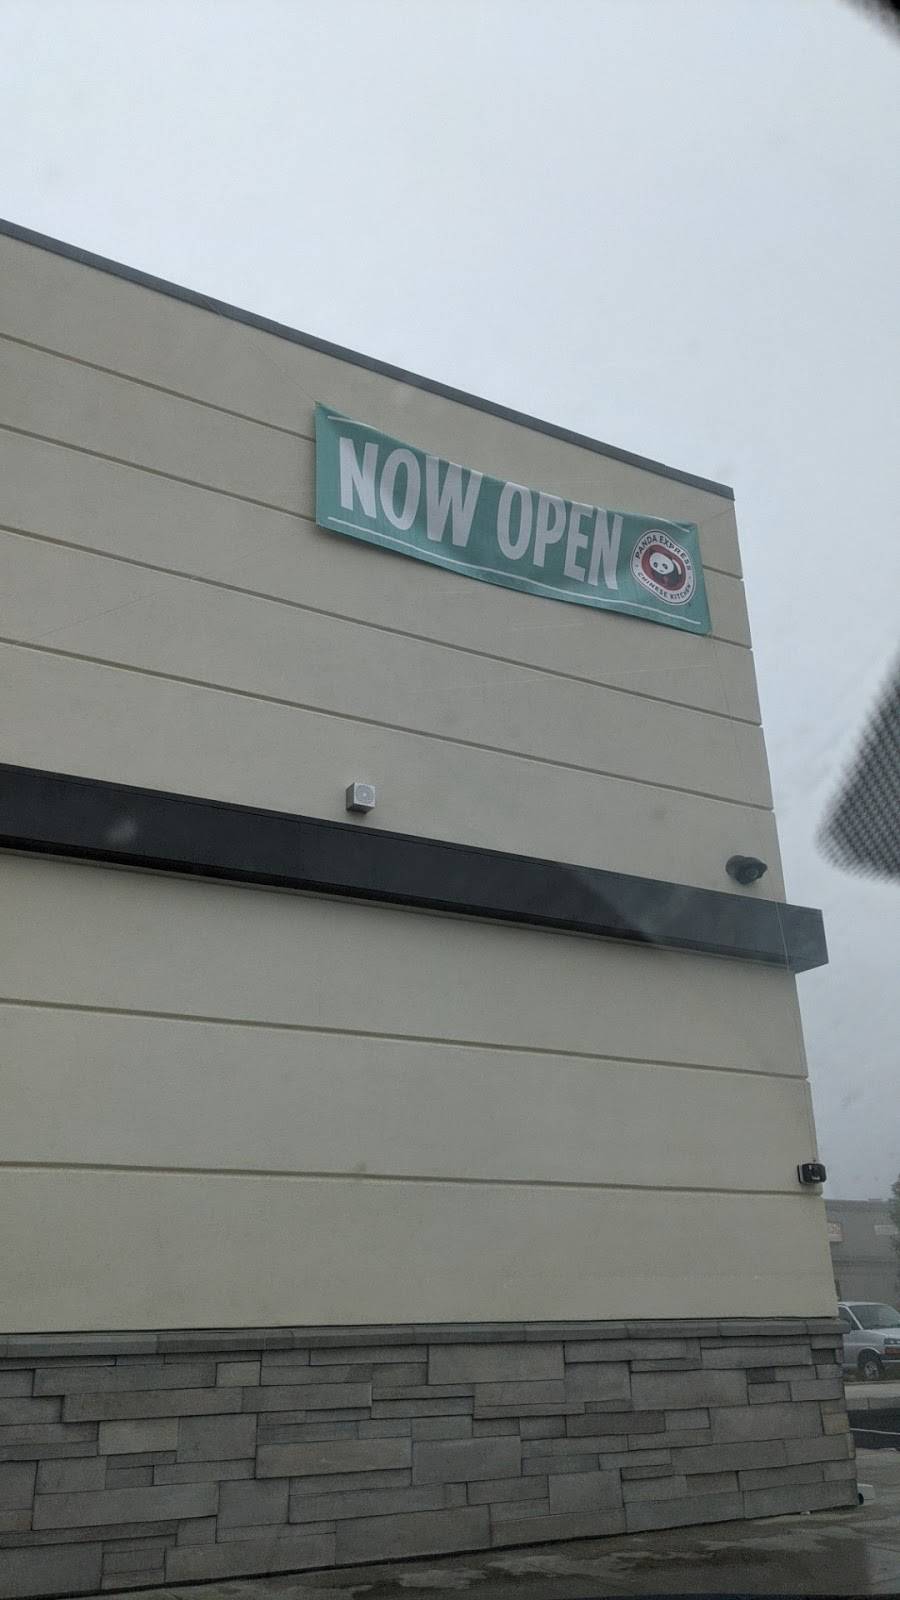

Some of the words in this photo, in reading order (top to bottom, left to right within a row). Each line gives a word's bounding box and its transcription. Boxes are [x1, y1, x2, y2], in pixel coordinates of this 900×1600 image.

[339, 438, 483, 547] NOW
[497, 482, 623, 590] OPEN
[635, 534, 657, 559] PANDA
[659, 535, 692, 571] EXPRESS
[638, 572, 670, 598] CHINESE
